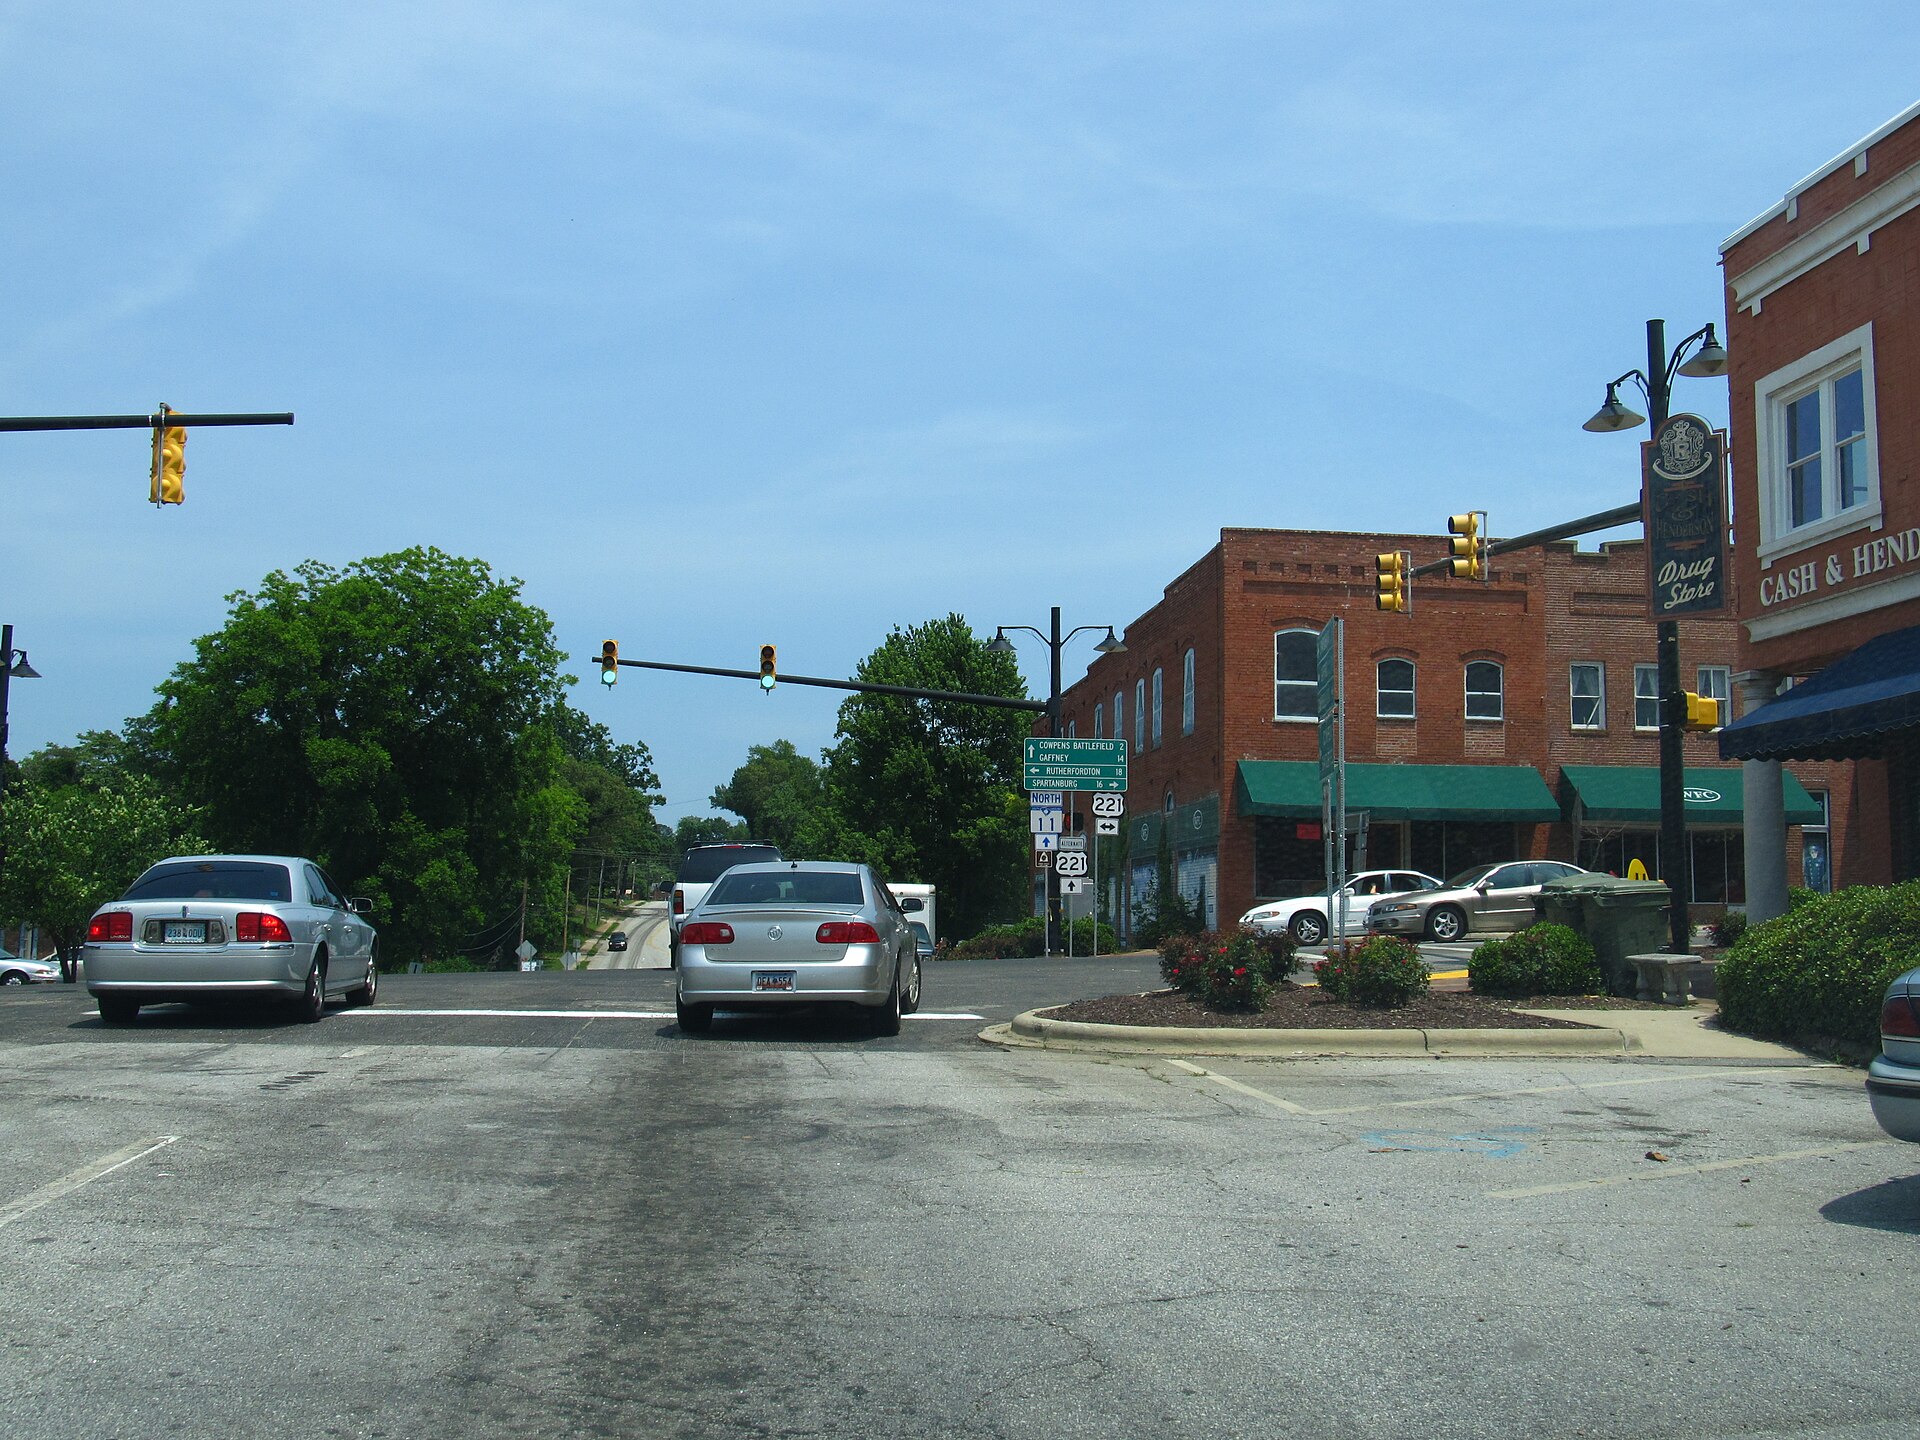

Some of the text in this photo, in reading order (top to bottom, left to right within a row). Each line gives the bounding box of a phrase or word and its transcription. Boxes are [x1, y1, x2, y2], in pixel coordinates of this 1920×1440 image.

[1658, 556, 1716, 587] Drug
[1760, 527, 1920, 607] CASH & HEND
[1663, 581, 1715, 609] Store
[1039, 741, 1071, 750] COWPENS
[1073, 742, 1114, 751] BATTLEFIELD
[1039, 754, 1125, 763] GAFFNEY 14
[1046, 767, 1123, 776] RUTHERFORDTON 18
[1032, 779, 1103, 788] SPARTANBURG 16
[1032, 793, 1061, 804] NORTH
[1095, 797, 1121, 812] 221
[1038, 817, 1054, 832] 11
[1058, 856, 1085, 871] 221
[167, 929, 182, 938] 238
